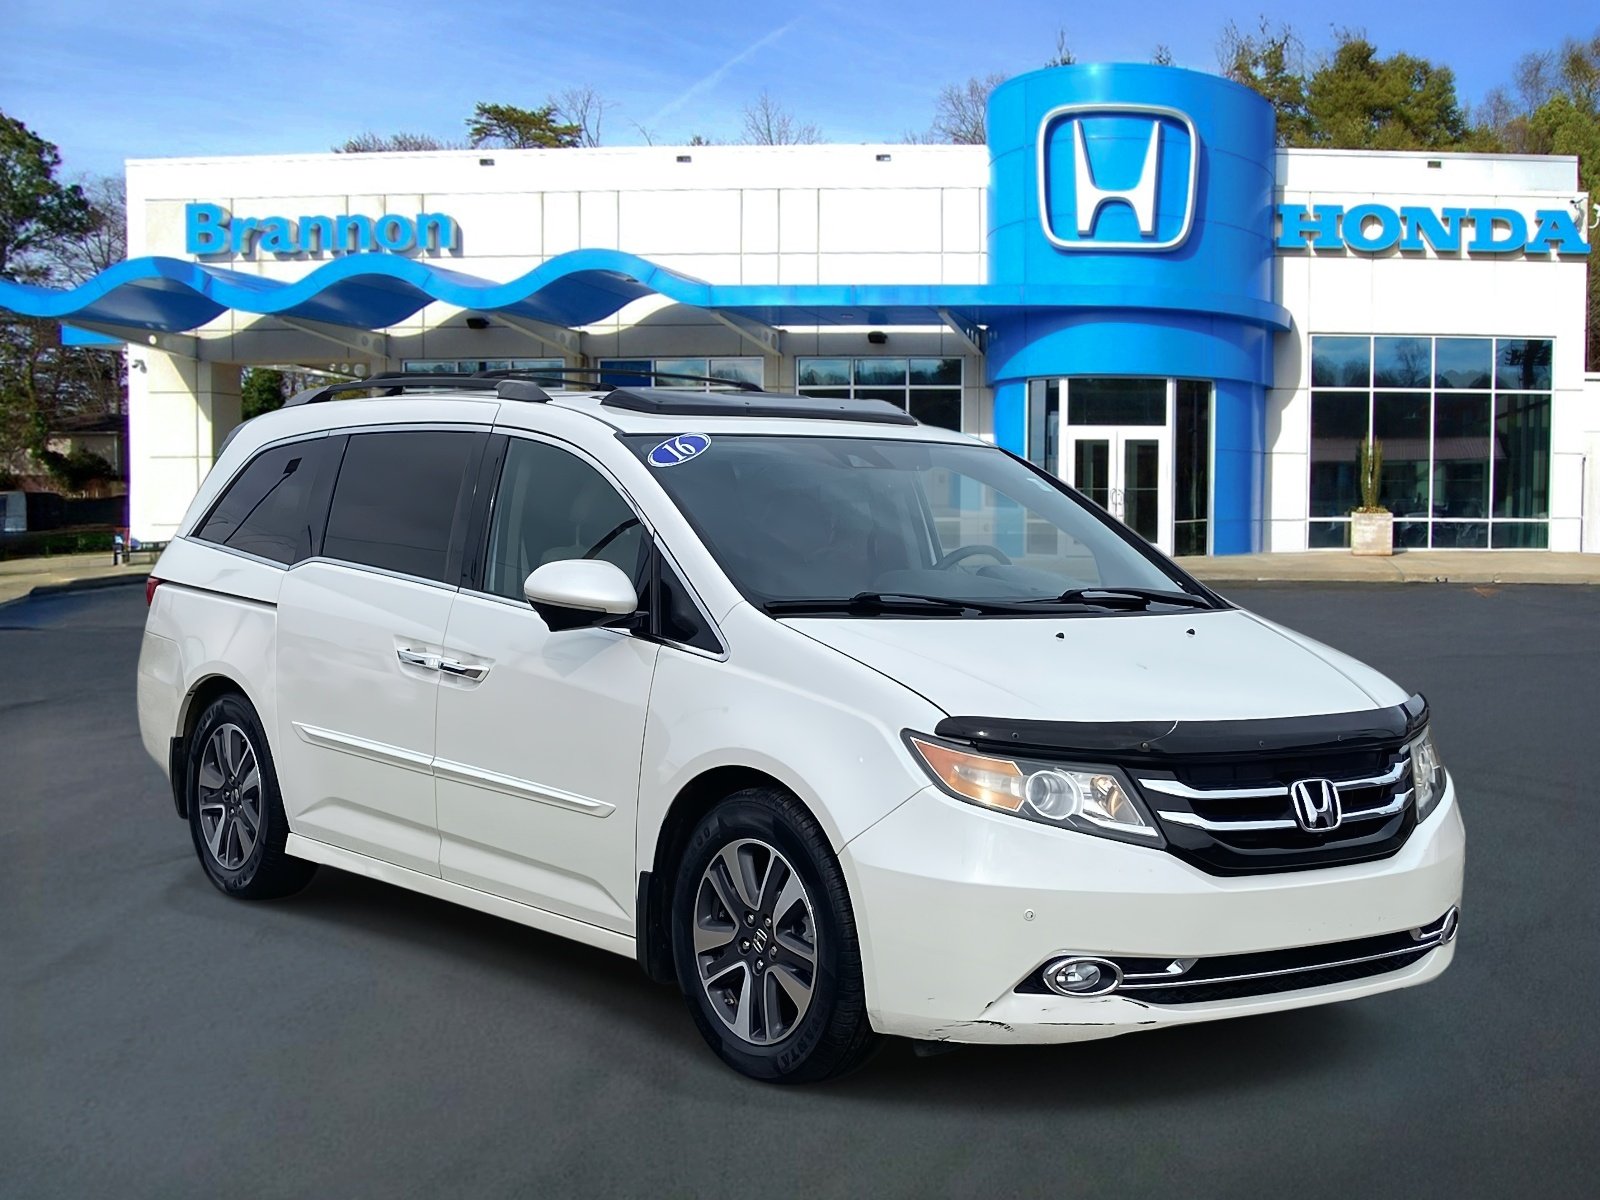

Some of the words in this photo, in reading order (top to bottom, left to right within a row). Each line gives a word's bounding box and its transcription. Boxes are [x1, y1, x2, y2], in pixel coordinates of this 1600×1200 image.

[185, 202, 456, 256] Brannon
[1276, 203, 1592, 256] HONDA
[662, 437, 696, 462] 16
